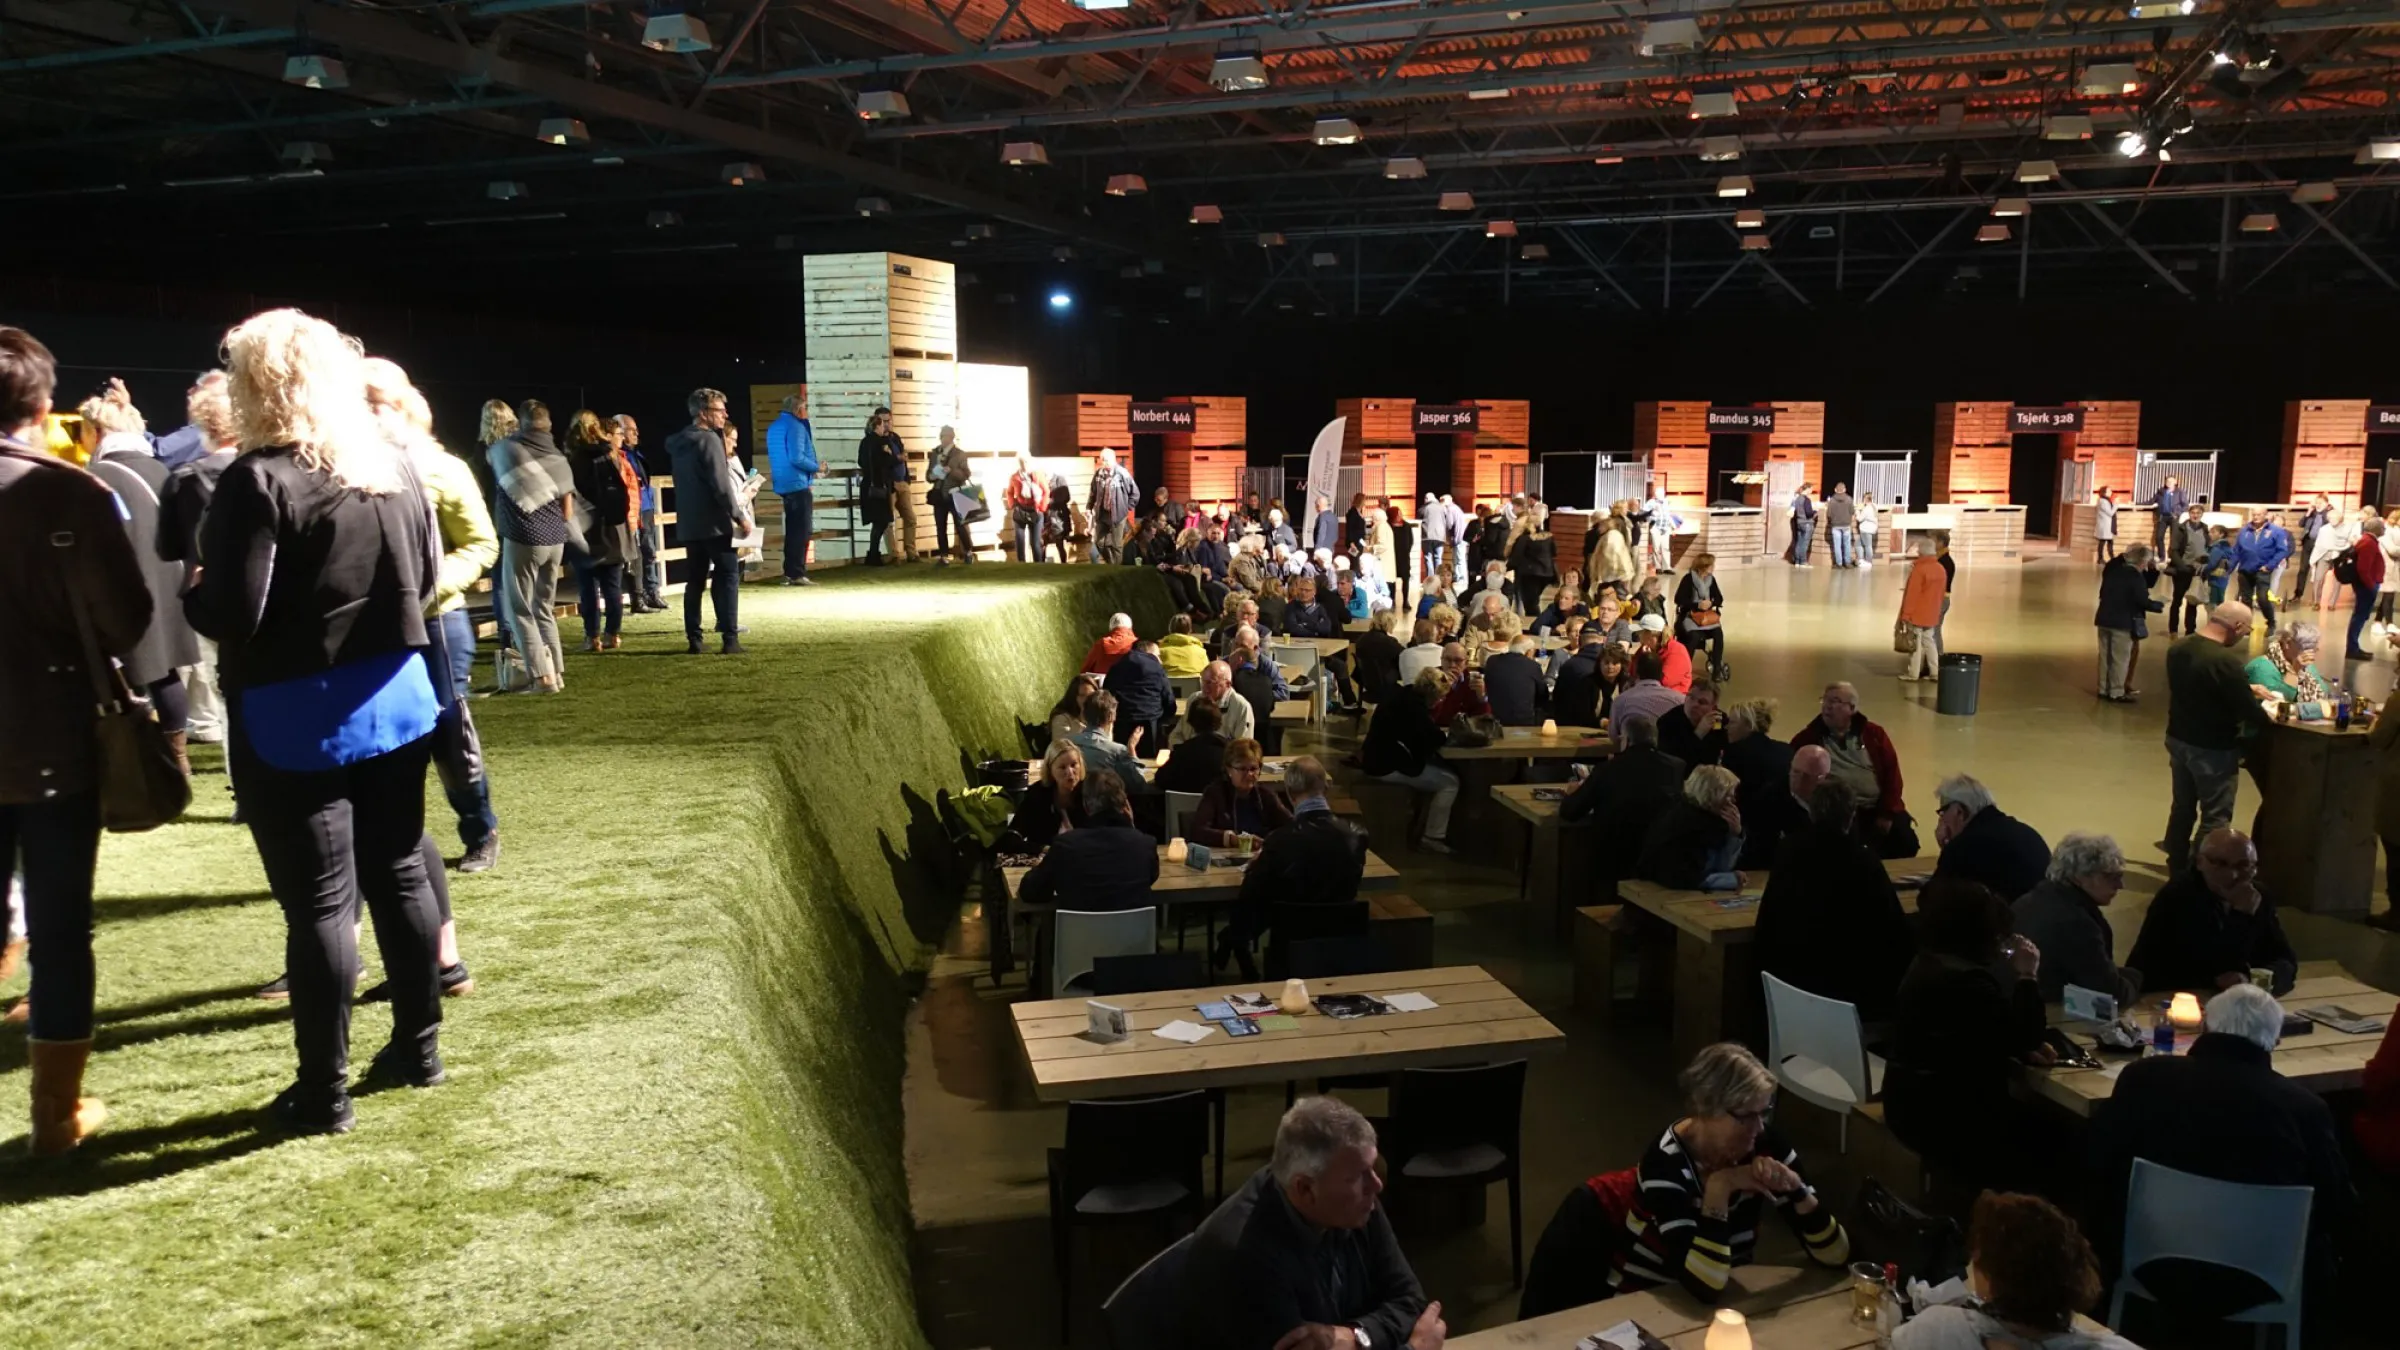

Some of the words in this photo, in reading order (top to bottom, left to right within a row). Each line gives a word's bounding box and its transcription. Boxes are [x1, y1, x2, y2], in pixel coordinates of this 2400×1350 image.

[1133, 409, 1170, 422] Norbert
[1172, 412, 1191, 425] 444
[1419, 411, 1450, 426] Jasper
[1452, 412, 1471, 426] 366
[1709, 412, 1749, 425] Brandus
[1752, 414, 1771, 427] 345
[2016, 412, 2050, 426] Tsjerk
[2052, 412, 2075, 426] 328
[1601, 454, 1612, 469] H
[2143, 452, 2154, 467] F
